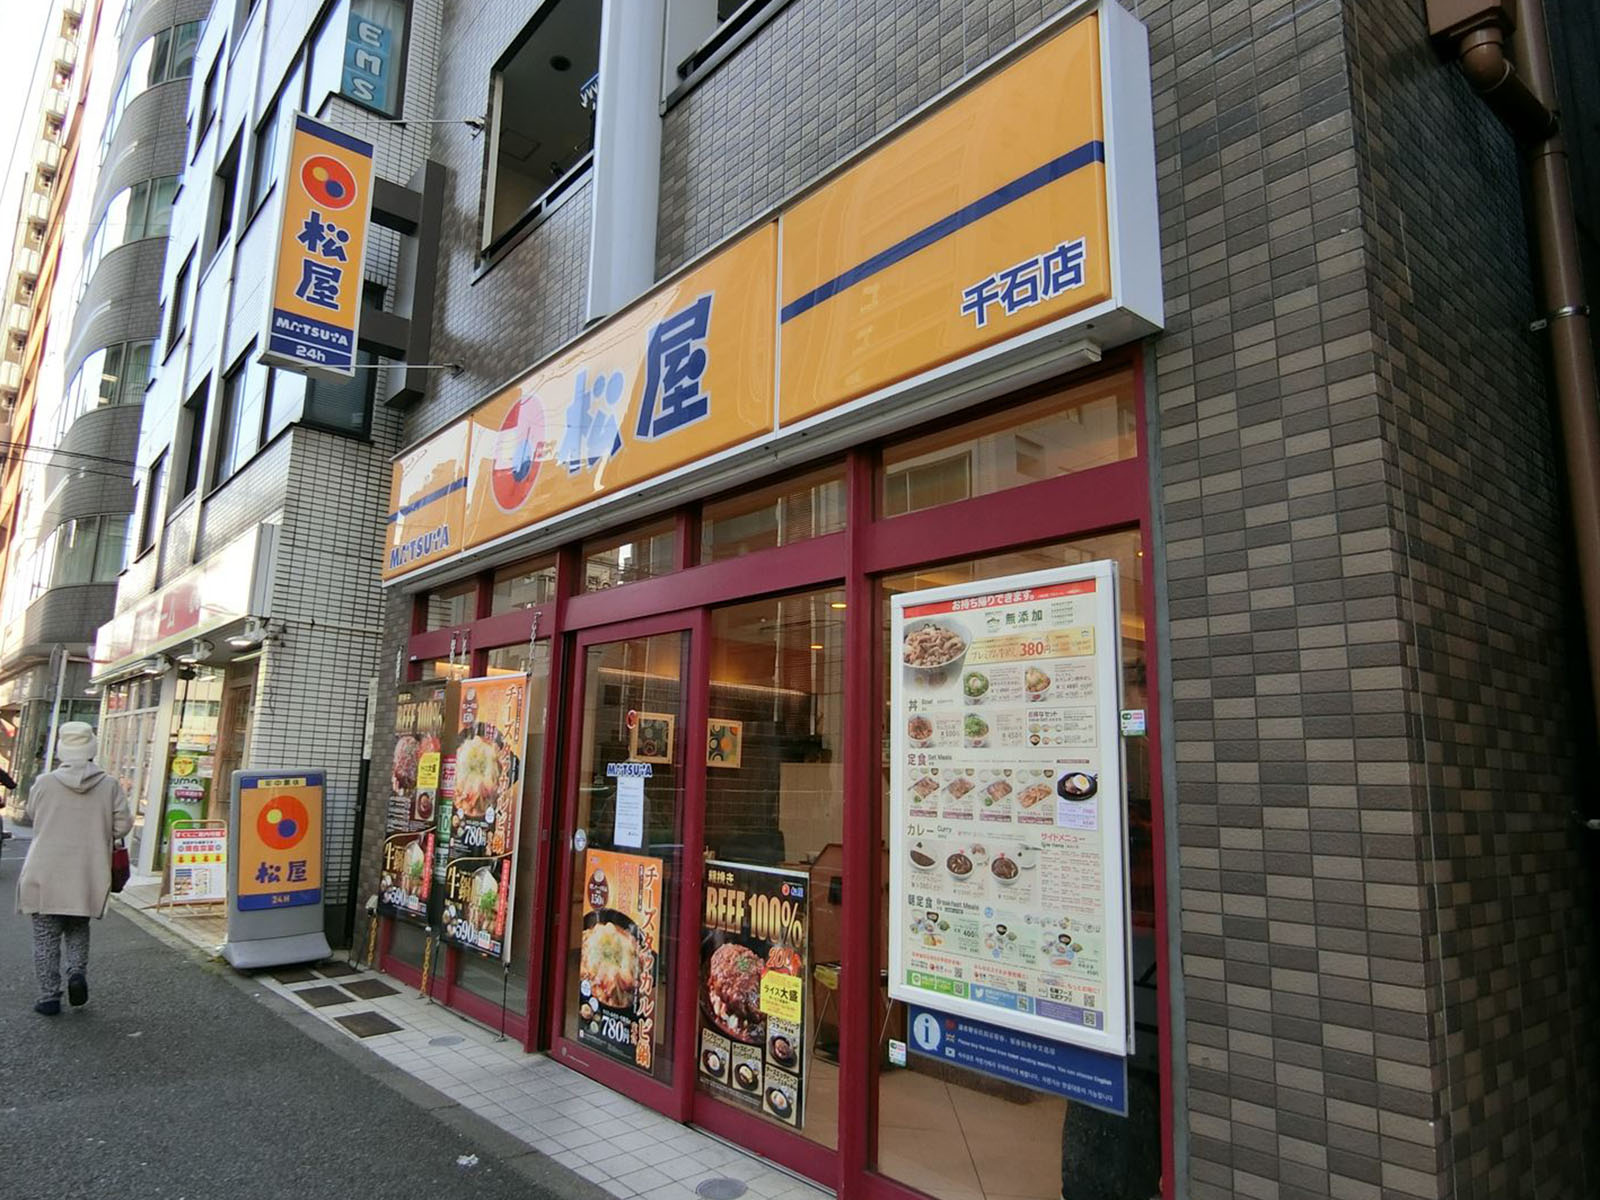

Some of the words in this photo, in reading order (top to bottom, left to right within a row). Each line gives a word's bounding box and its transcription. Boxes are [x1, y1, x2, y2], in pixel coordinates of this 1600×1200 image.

[352, 22, 382, 101] EMS
[296, 210, 351, 312] 松屋
[961, 236, 1086, 328] 千石店
[276, 317, 348, 346] MATSUYA
[296, 345, 326, 362] 24h
[557, 290, 716, 474] 松屋
[390, 524, 449, 570] MATSUYA
[1006, 610, 1042, 625] 無添加
[908, 753, 926, 765] 定食
[907, 824, 934, 836] カレー
[255, 860, 307, 884] 松屋
[705, 886, 745, 934] BEEF
[749, 893, 802, 948] 100%
[602, 1015, 629, 1044] 780円
